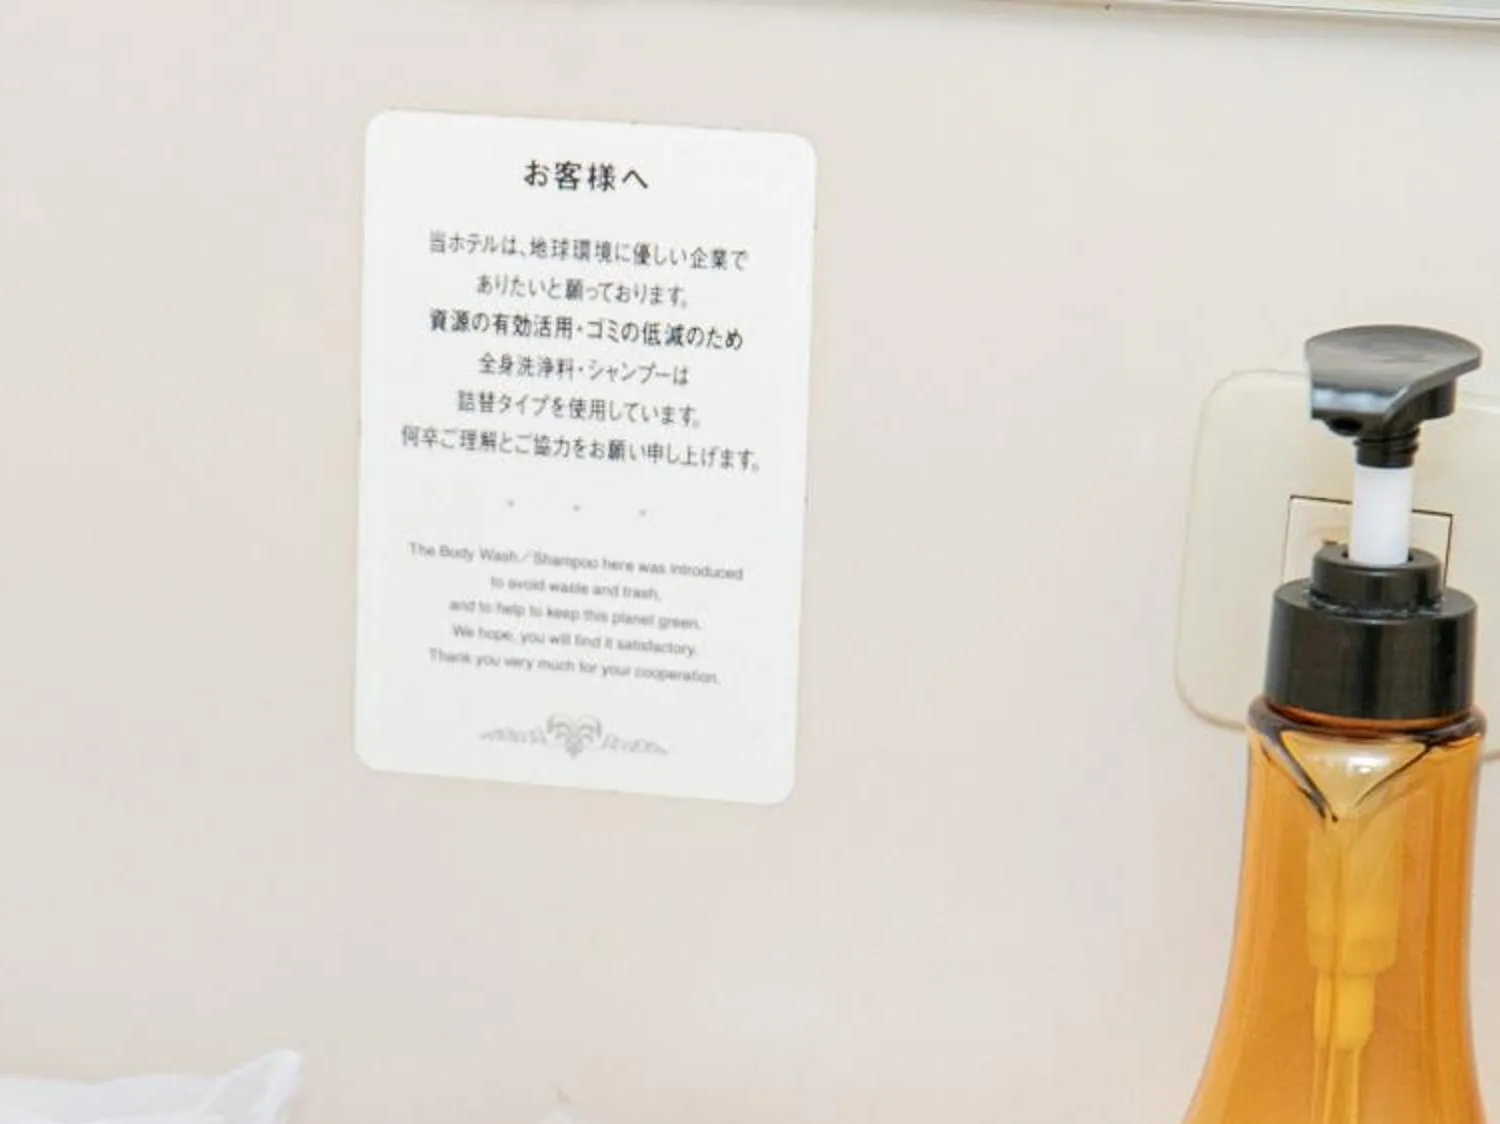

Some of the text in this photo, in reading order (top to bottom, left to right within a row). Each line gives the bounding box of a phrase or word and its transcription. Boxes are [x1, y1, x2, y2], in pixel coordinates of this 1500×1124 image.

[523, 159, 649, 192] お客様へ
[476, 274, 688, 309] ありたいと願っております。
[457, 389, 700, 428] 詰替タイプを使用しています。
[409, 541, 435, 556] The
[439, 544, 474, 563] Body
[602, 557, 634, 572] here
[638, 561, 666, 574] was
[670, 563, 744, 581] introduced
[490, 576, 504, 589] to
[508, 578, 545, 592] avoid
[549, 582, 589, 595] waste
[592, 583, 619, 597] and
[449, 600, 476, 612] and
[479, 600, 493, 613] to
[497, 602, 525, 618] help
[529, 605, 543, 617] to
[546, 605, 580, 623] keep
[583, 609, 609, 624] this
[612, 611, 655, 627] planet
[452, 624, 475, 638] We
[520, 632, 545, 646] you
[549, 633, 571, 646] will
[574, 633, 601, 649] find
[604, 637, 613, 649] it
[429, 647, 722, 686] Thank you very much for your cooperation.
